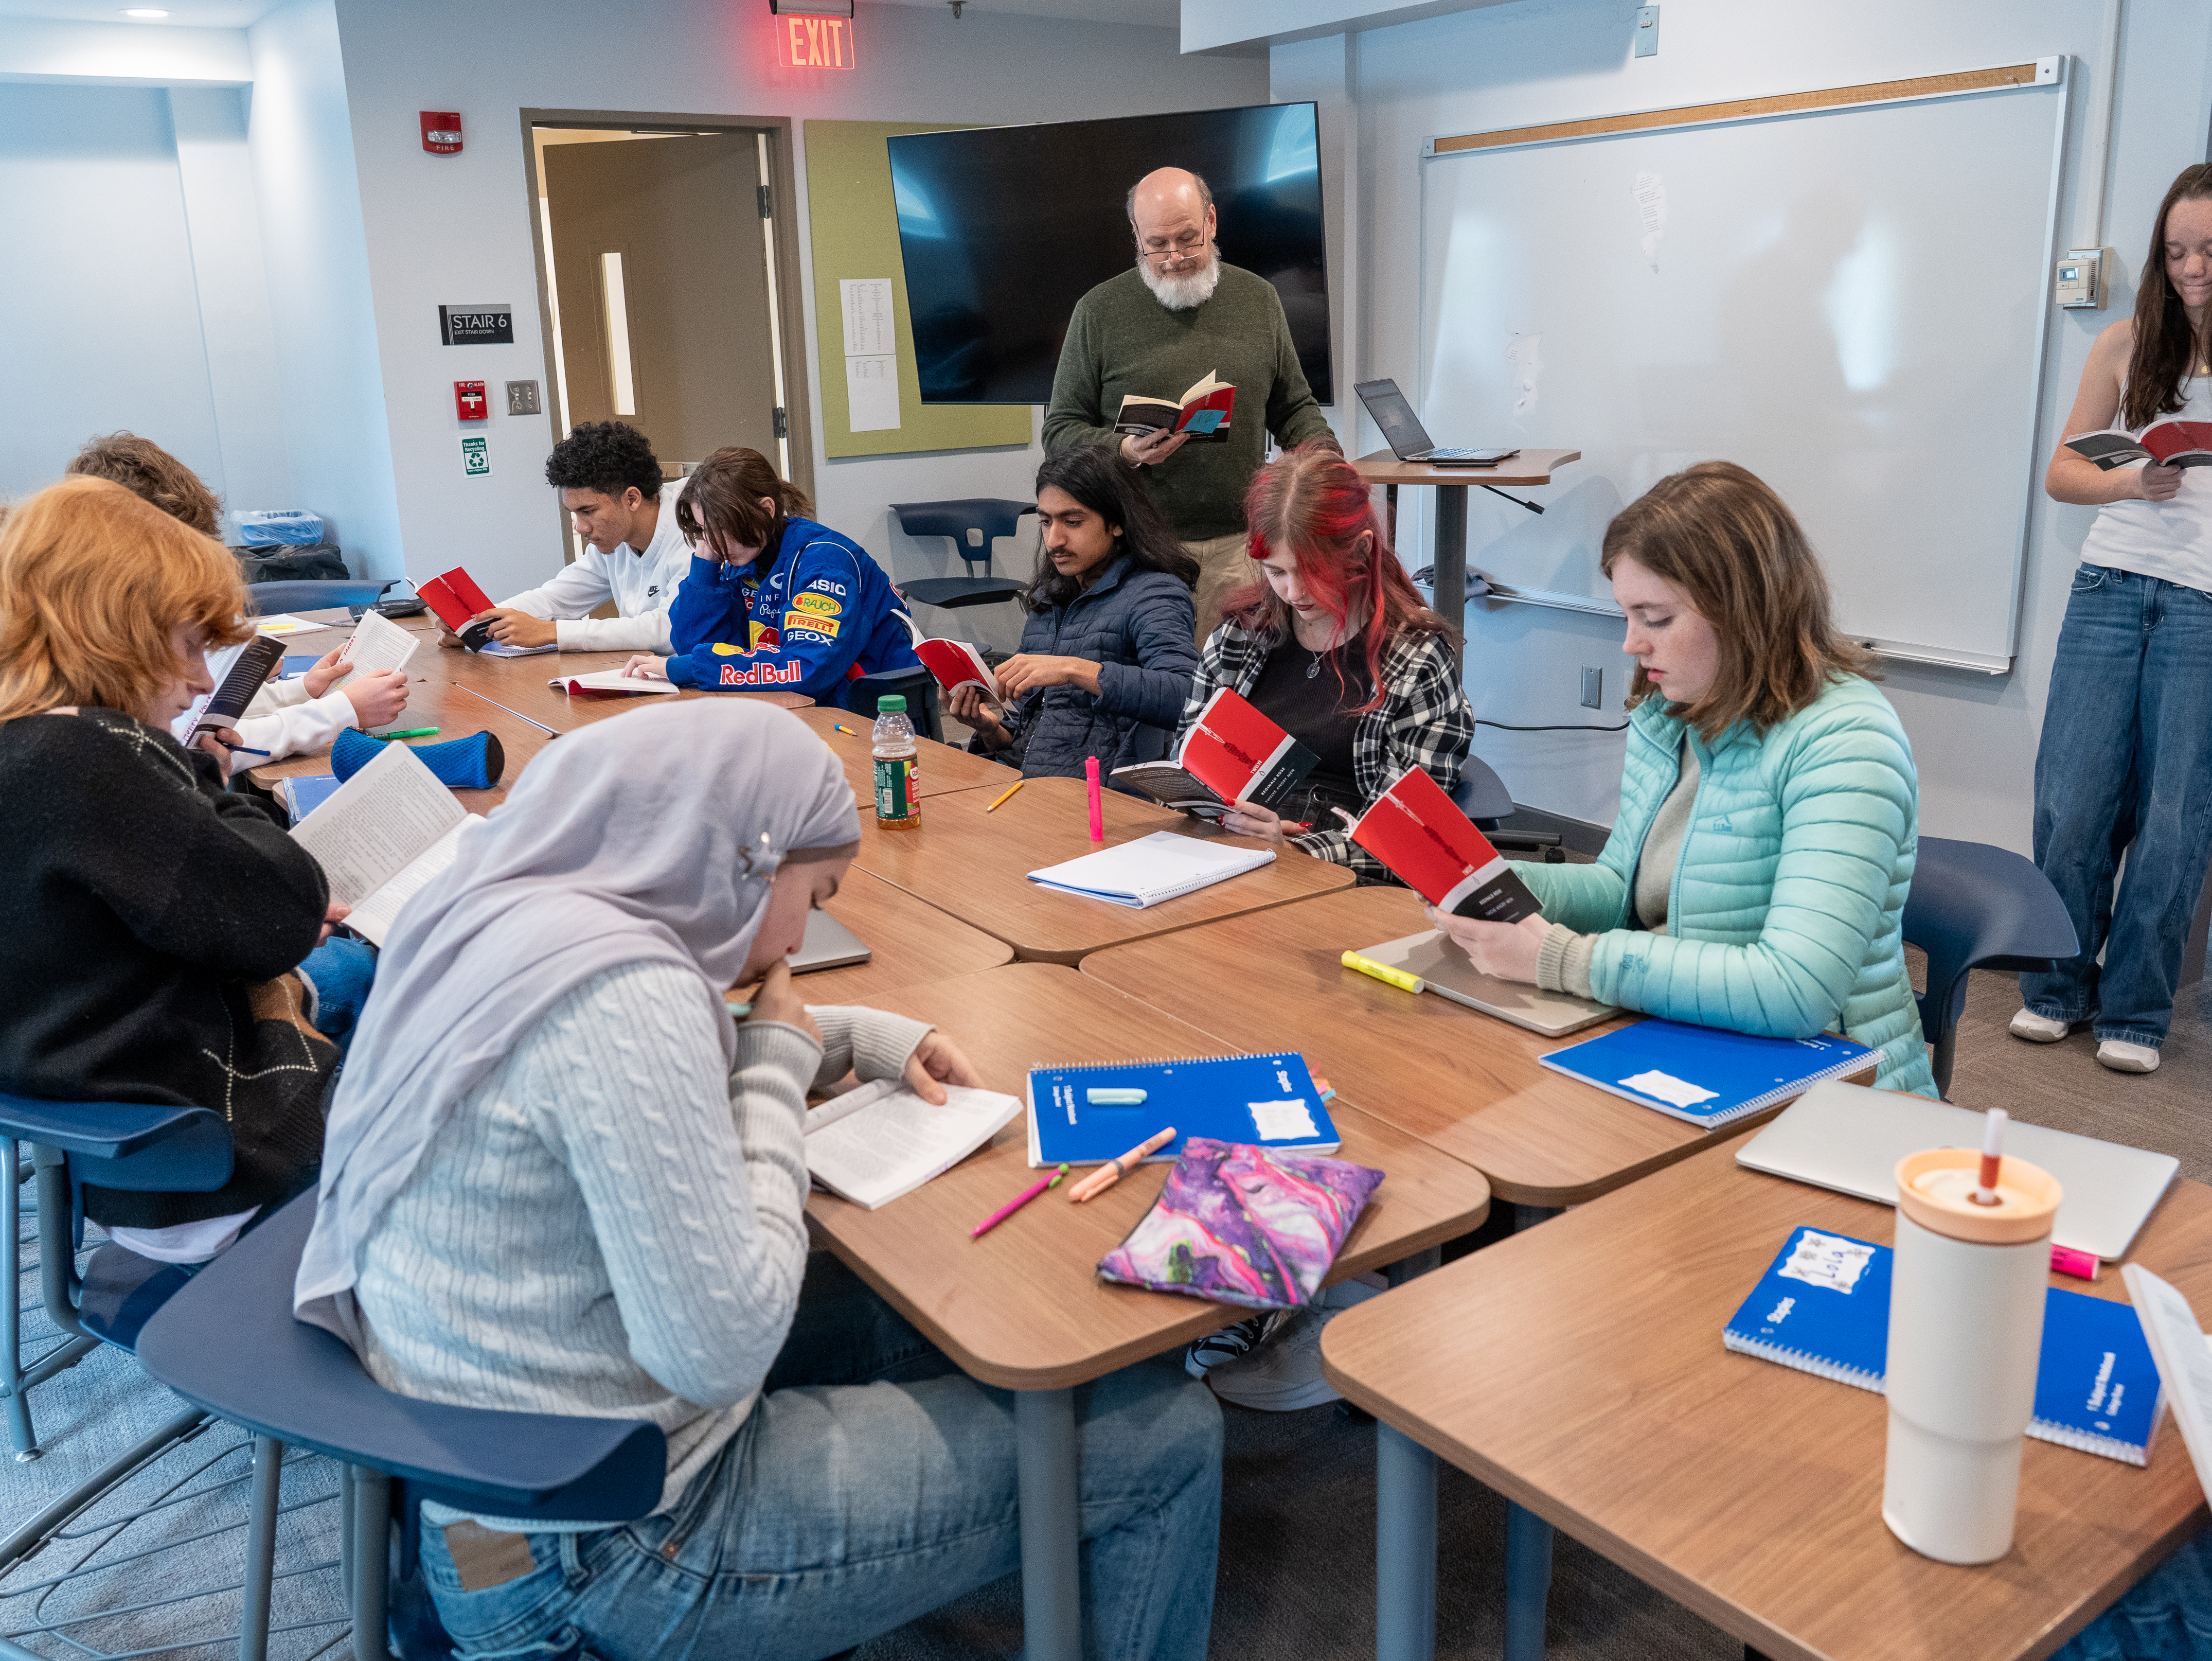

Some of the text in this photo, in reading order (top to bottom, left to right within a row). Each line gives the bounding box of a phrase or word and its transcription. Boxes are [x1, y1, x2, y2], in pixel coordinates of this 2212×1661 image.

[788, 17, 843, 67] EXIT
[453, 314, 507, 328] STAIR 6
[803, 598, 836, 613] RAUCH
[788, 615, 834, 633] PIRELLI
[788, 630, 834, 647] GEOX
[720, 660, 802, 685] Red Bull
[1250, 759, 1263, 774] TWELVE
[1261, 767, 1286, 796] REGINALD ROSE
[1265, 768, 1295, 803] TWELVE ANGRY MEN
